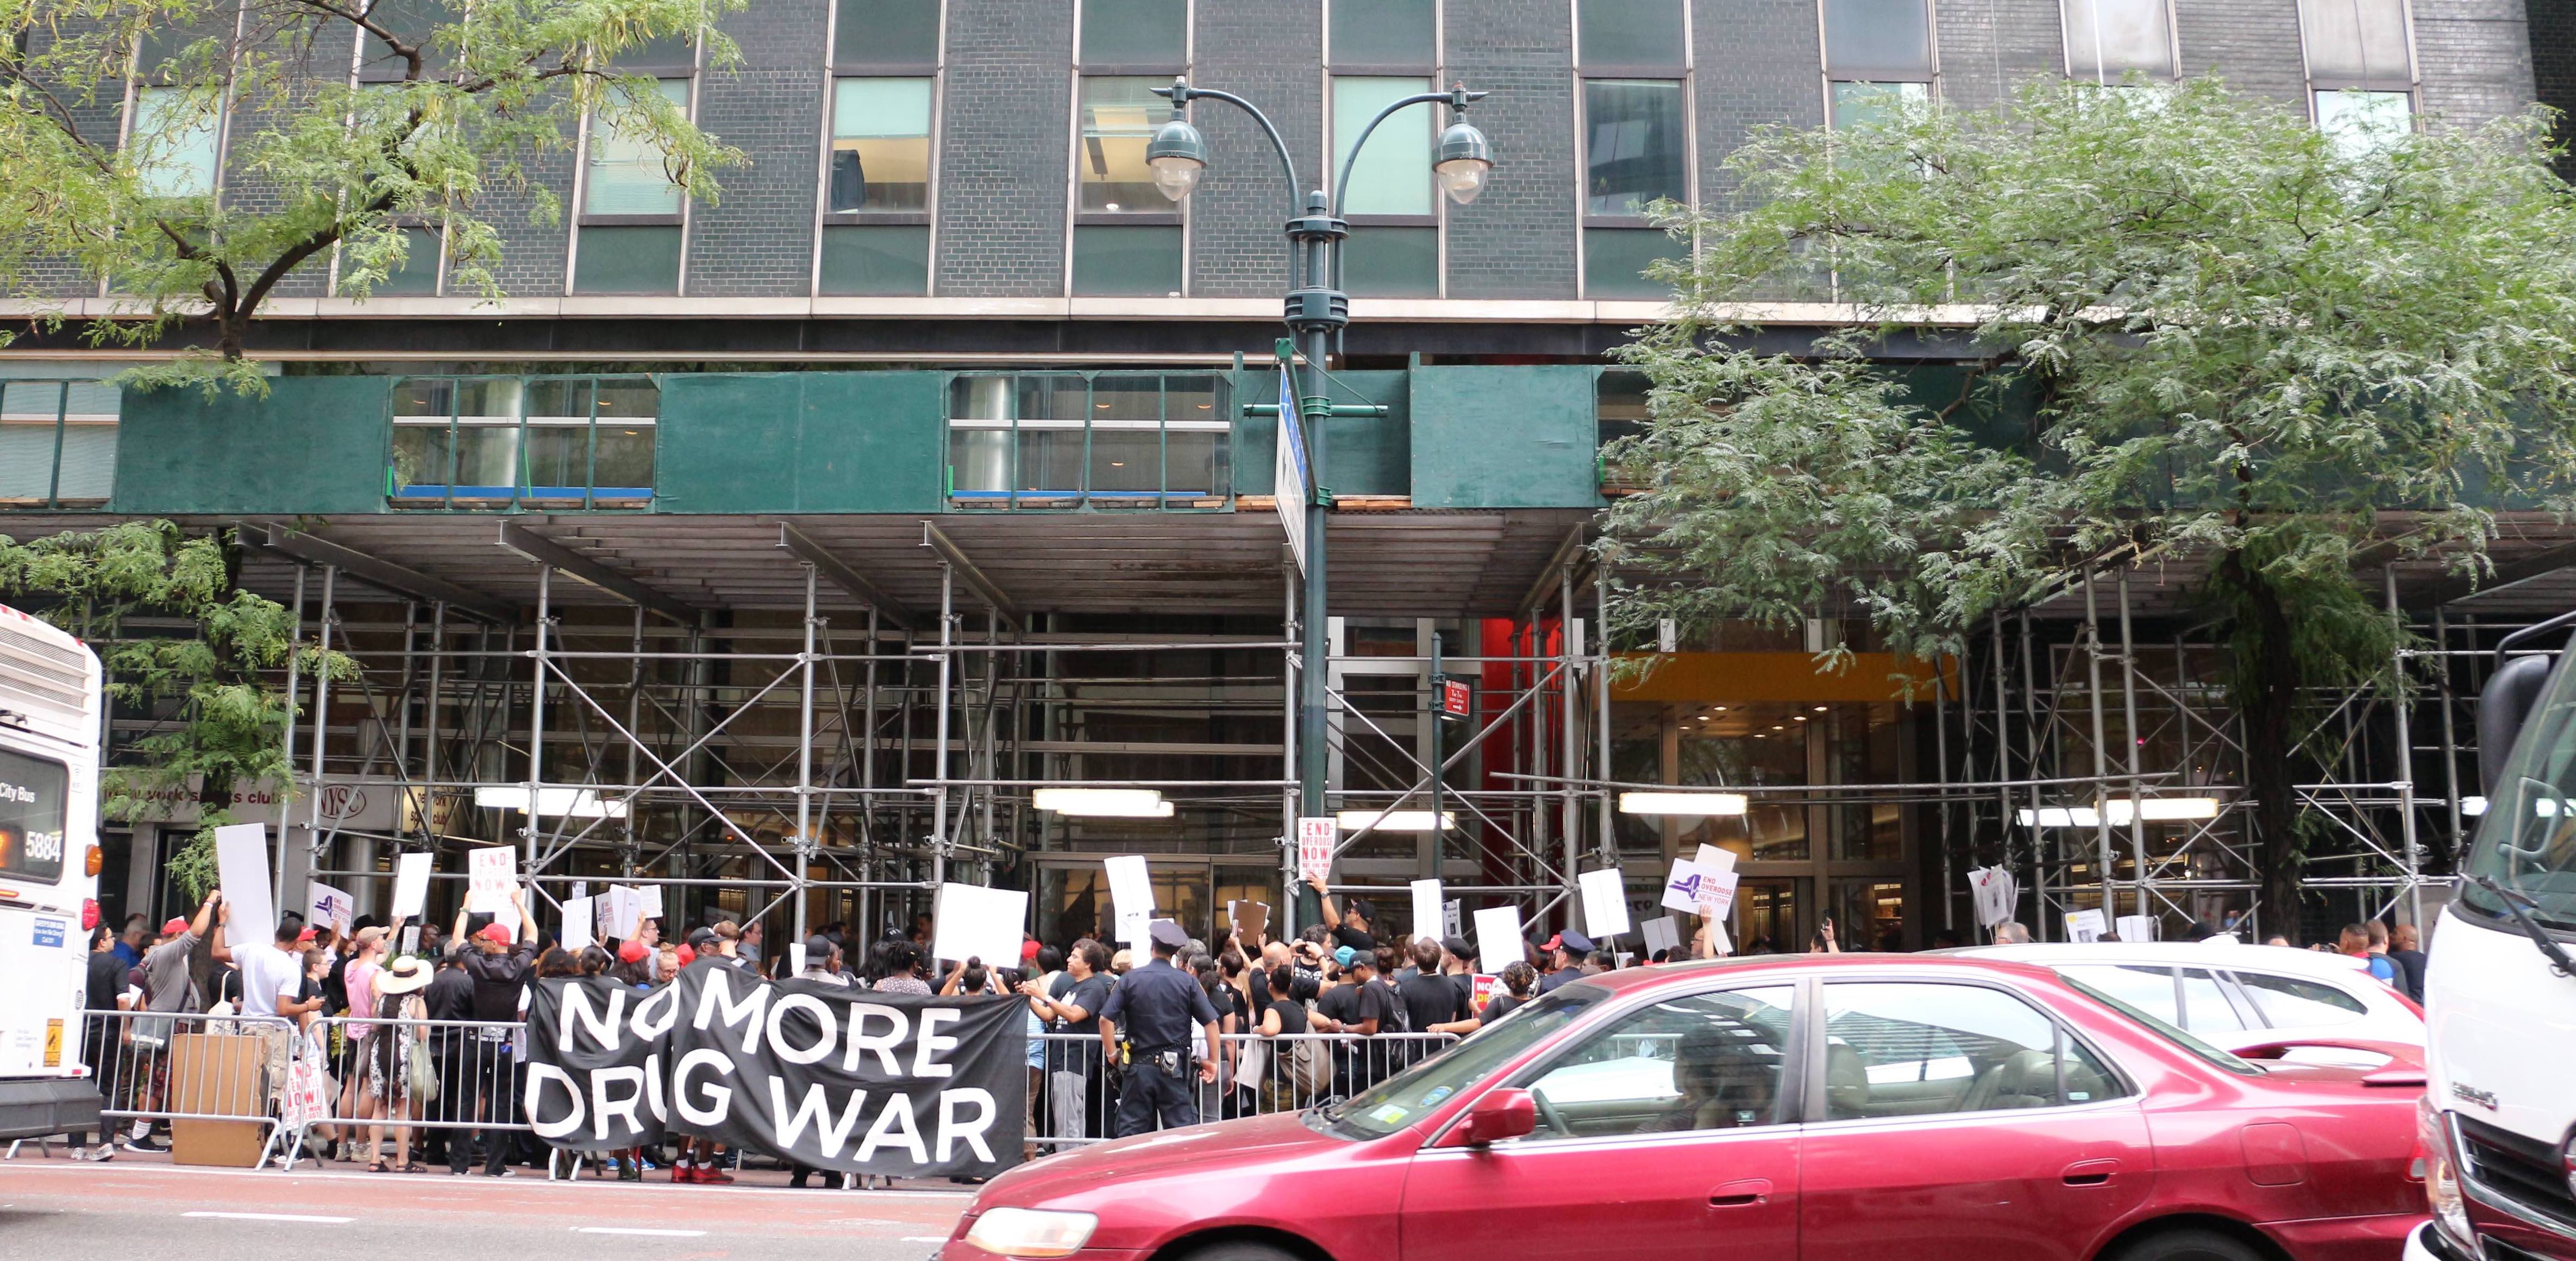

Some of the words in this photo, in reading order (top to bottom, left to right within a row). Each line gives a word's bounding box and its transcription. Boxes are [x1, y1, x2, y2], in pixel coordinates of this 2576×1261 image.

[0, 782, 17, 802] City
[18, 786, 35, 803] Bus
[1307, 823, 1330, 836] END
[26, 831, 62, 862] 5884
[1302, 837, 1333, 846] OVERDOSE
[480, 852, 506, 867] END
[1703, 876, 1716, 884] END
[1701, 883, 1733, 895] OVERDOSE
[1698, 894, 1713, 902] NEW
[1714, 898, 1730, 906] YORK
[559, 977, 680, 1052] NO
[693, 967, 961, 1077] MORE
[769, 1075, 996, 1164] WAR
